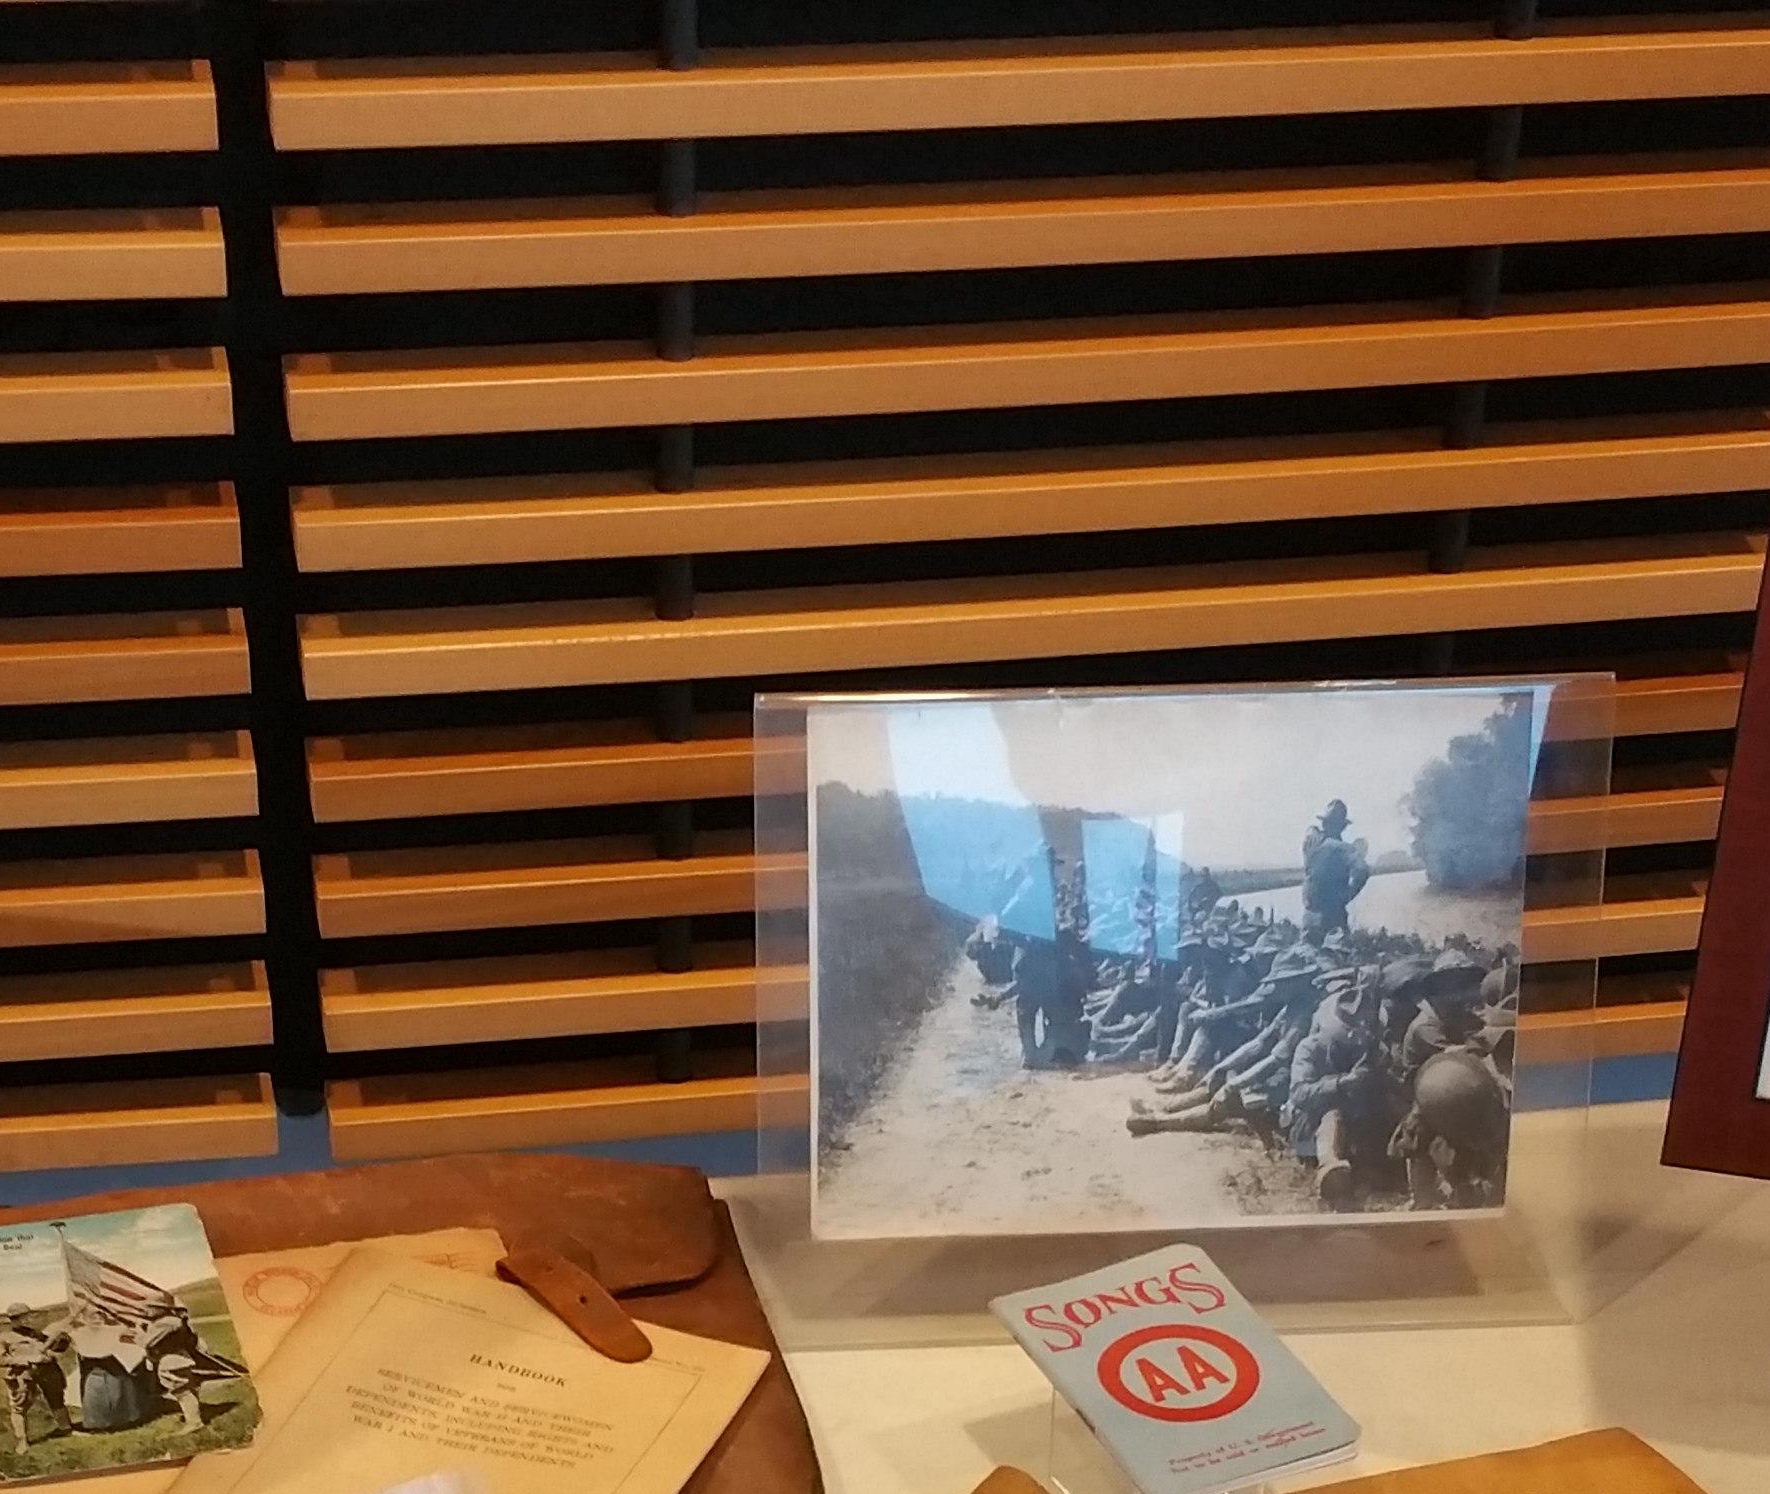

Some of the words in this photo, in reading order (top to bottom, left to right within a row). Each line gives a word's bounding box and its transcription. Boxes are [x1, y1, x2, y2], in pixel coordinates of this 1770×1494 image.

[1024, 1262, 1226, 1353] SONGS
[376, 1367, 466, 1399] SERVICEMEN
[469, 1391, 501, 1407] AND
[503, 1399, 614, 1433] SERVICEWOMEN
[469, 1353, 566, 1388] HANDBOOK
[1134, 1344, 1229, 1405] AA
[343, 1385, 440, 1418] DEPENDENTS,
[446, 1410, 522, 1437] INCLUDING
[527, 1426, 579, 1447] RIGHTS
[583, 1439, 614, 1455] AND
[349, 1399, 417, 1425] BENEFITS
[421, 1417, 440, 1430] OF
[445, 1422, 516, 1447] VETERANS
[519, 1437, 538, 1450] OF
[544, 1441, 595, 1462] WORLD
[382, 1382, 399, 1395] OF
[406, 1387, 456, 1409] WORLD
[461, 1401, 491, 1418] WAR
[513, 1412, 542, 1428] AND
[548, 1419, 592, 1439] THEIR
[352, 1414, 383, 1430] WAR
[400, 1427, 429, 1442] AND
[436, 1435, 477, 1452] THEIR
[483, 1443, 575, 1470] DEPENDENTS
